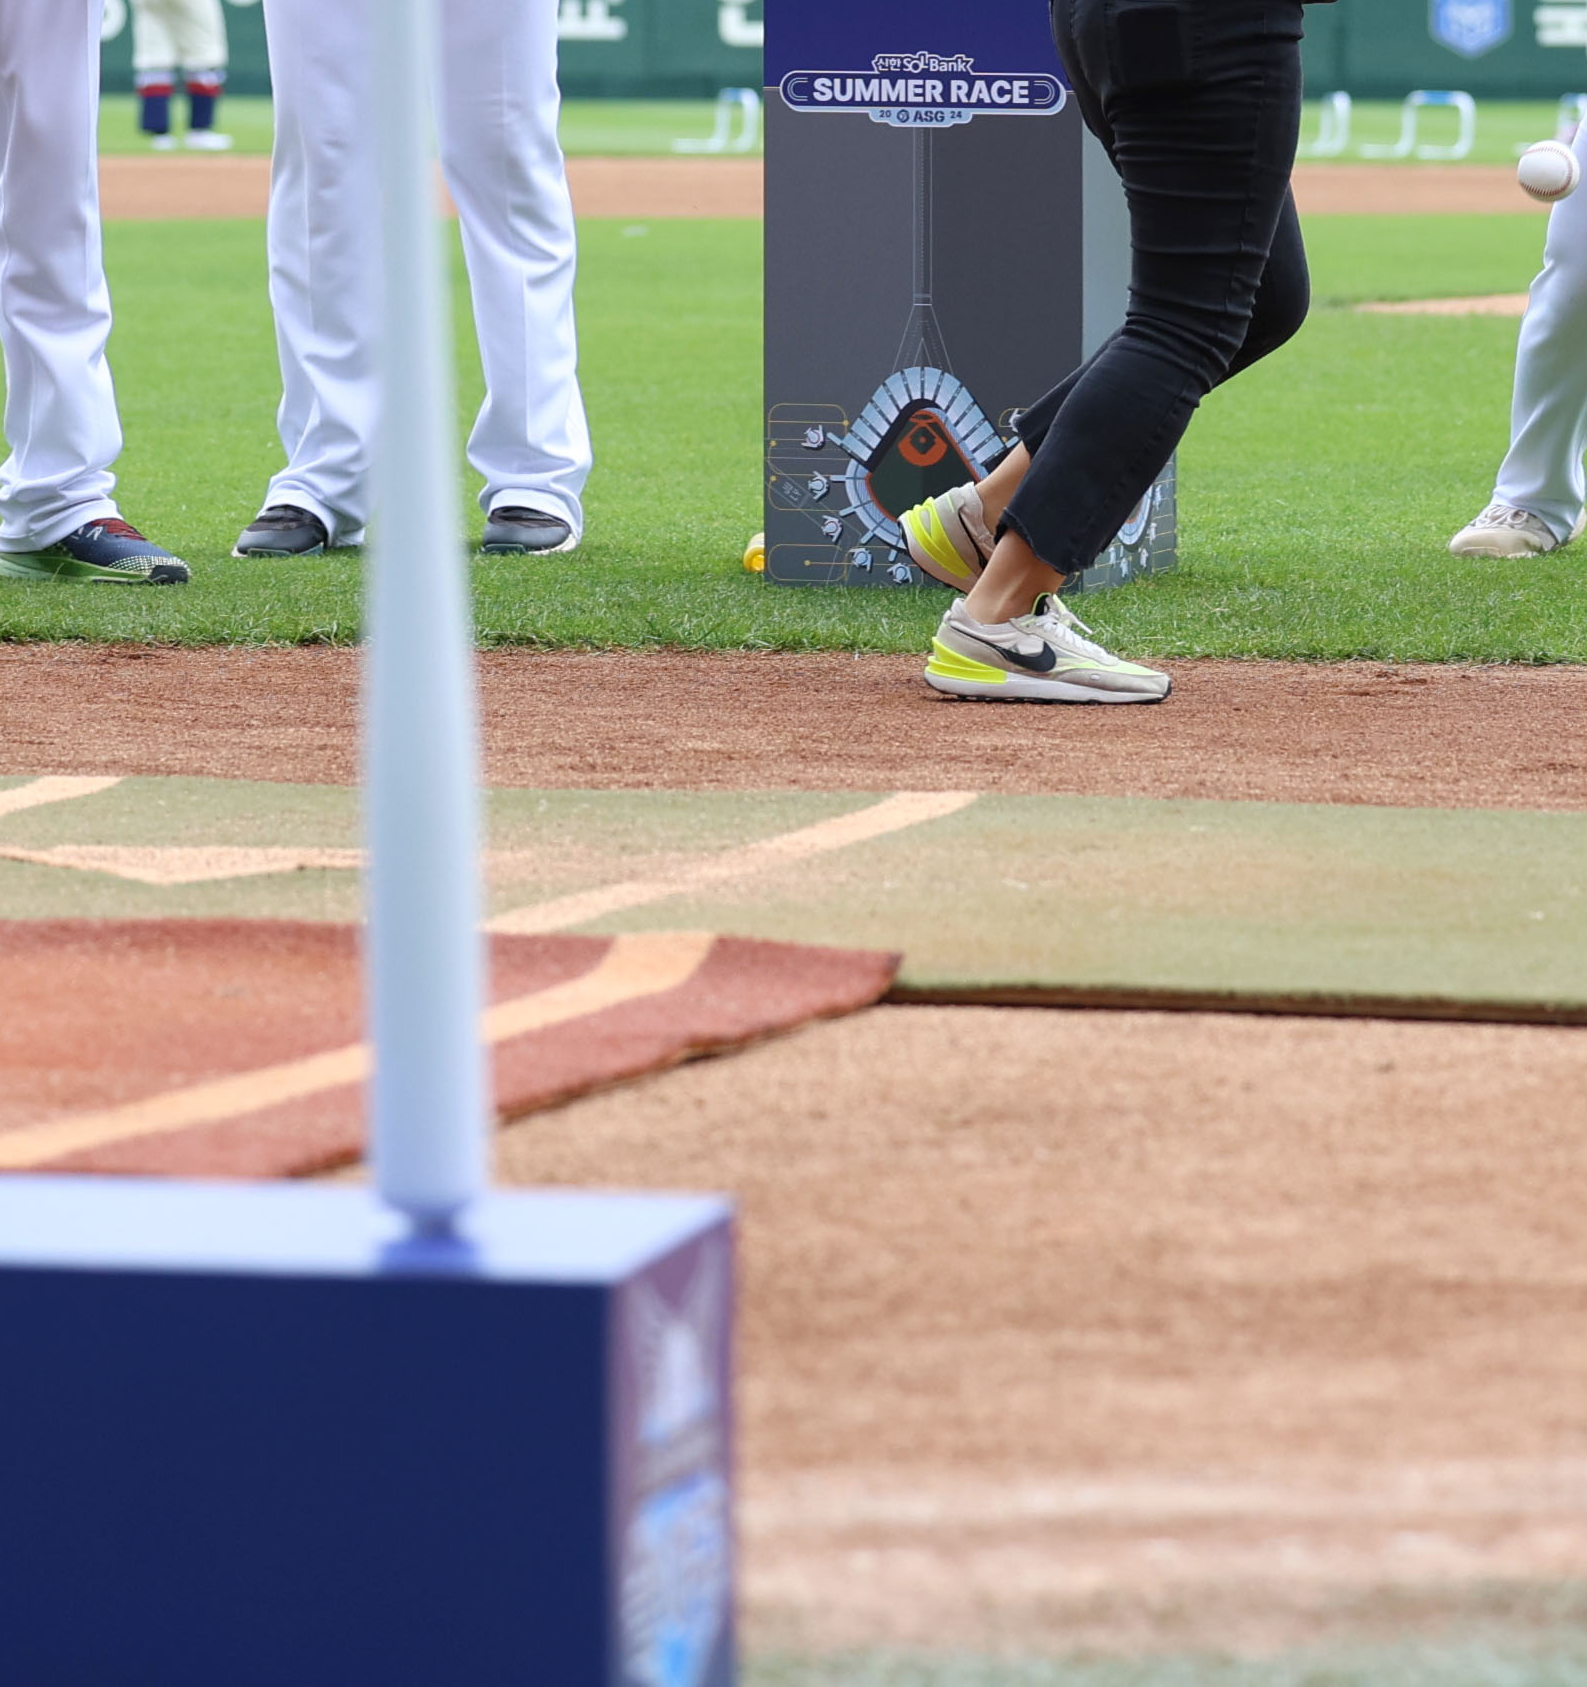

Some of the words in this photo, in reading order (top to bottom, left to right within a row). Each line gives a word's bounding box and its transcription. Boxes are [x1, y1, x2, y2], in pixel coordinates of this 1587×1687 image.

[877, 58, 901, 71] 신한
[929, 58, 967, 72] Bank
[813, 78, 944, 103] SUMMER
[950, 80, 1030, 104] RACE
[879, 110, 892, 118] 20
[913, 110, 946, 123] ASG
[949, 110, 963, 119] 24
